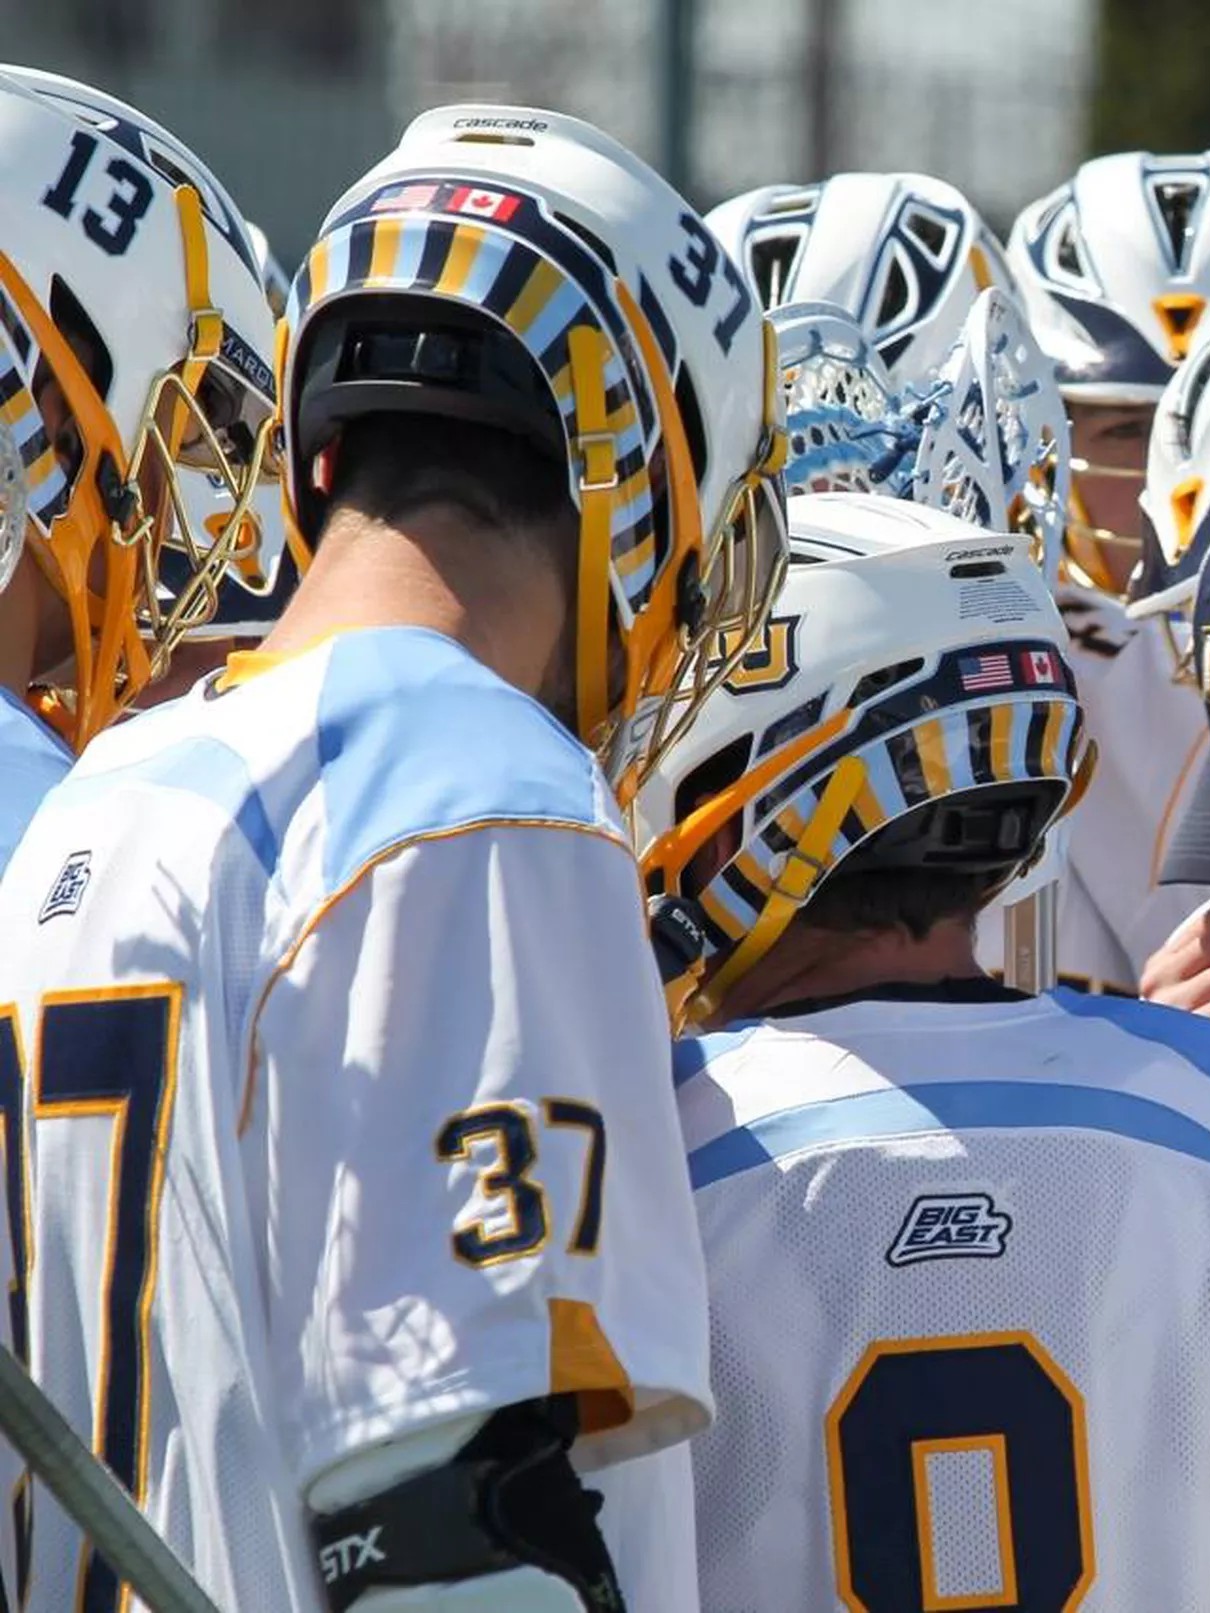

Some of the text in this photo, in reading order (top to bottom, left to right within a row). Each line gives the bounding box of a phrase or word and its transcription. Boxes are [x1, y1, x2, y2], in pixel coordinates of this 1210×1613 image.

[453, 117, 548, 132] cascade
[42, 129, 155, 256] 13
[667, 210, 752, 358] 37
[435, 1096, 606, 1270] 37
[904, 1224, 999, 1246] EAST
[915, 1205, 982, 1226] BIG
[320, 1526, 386, 1583] STX
